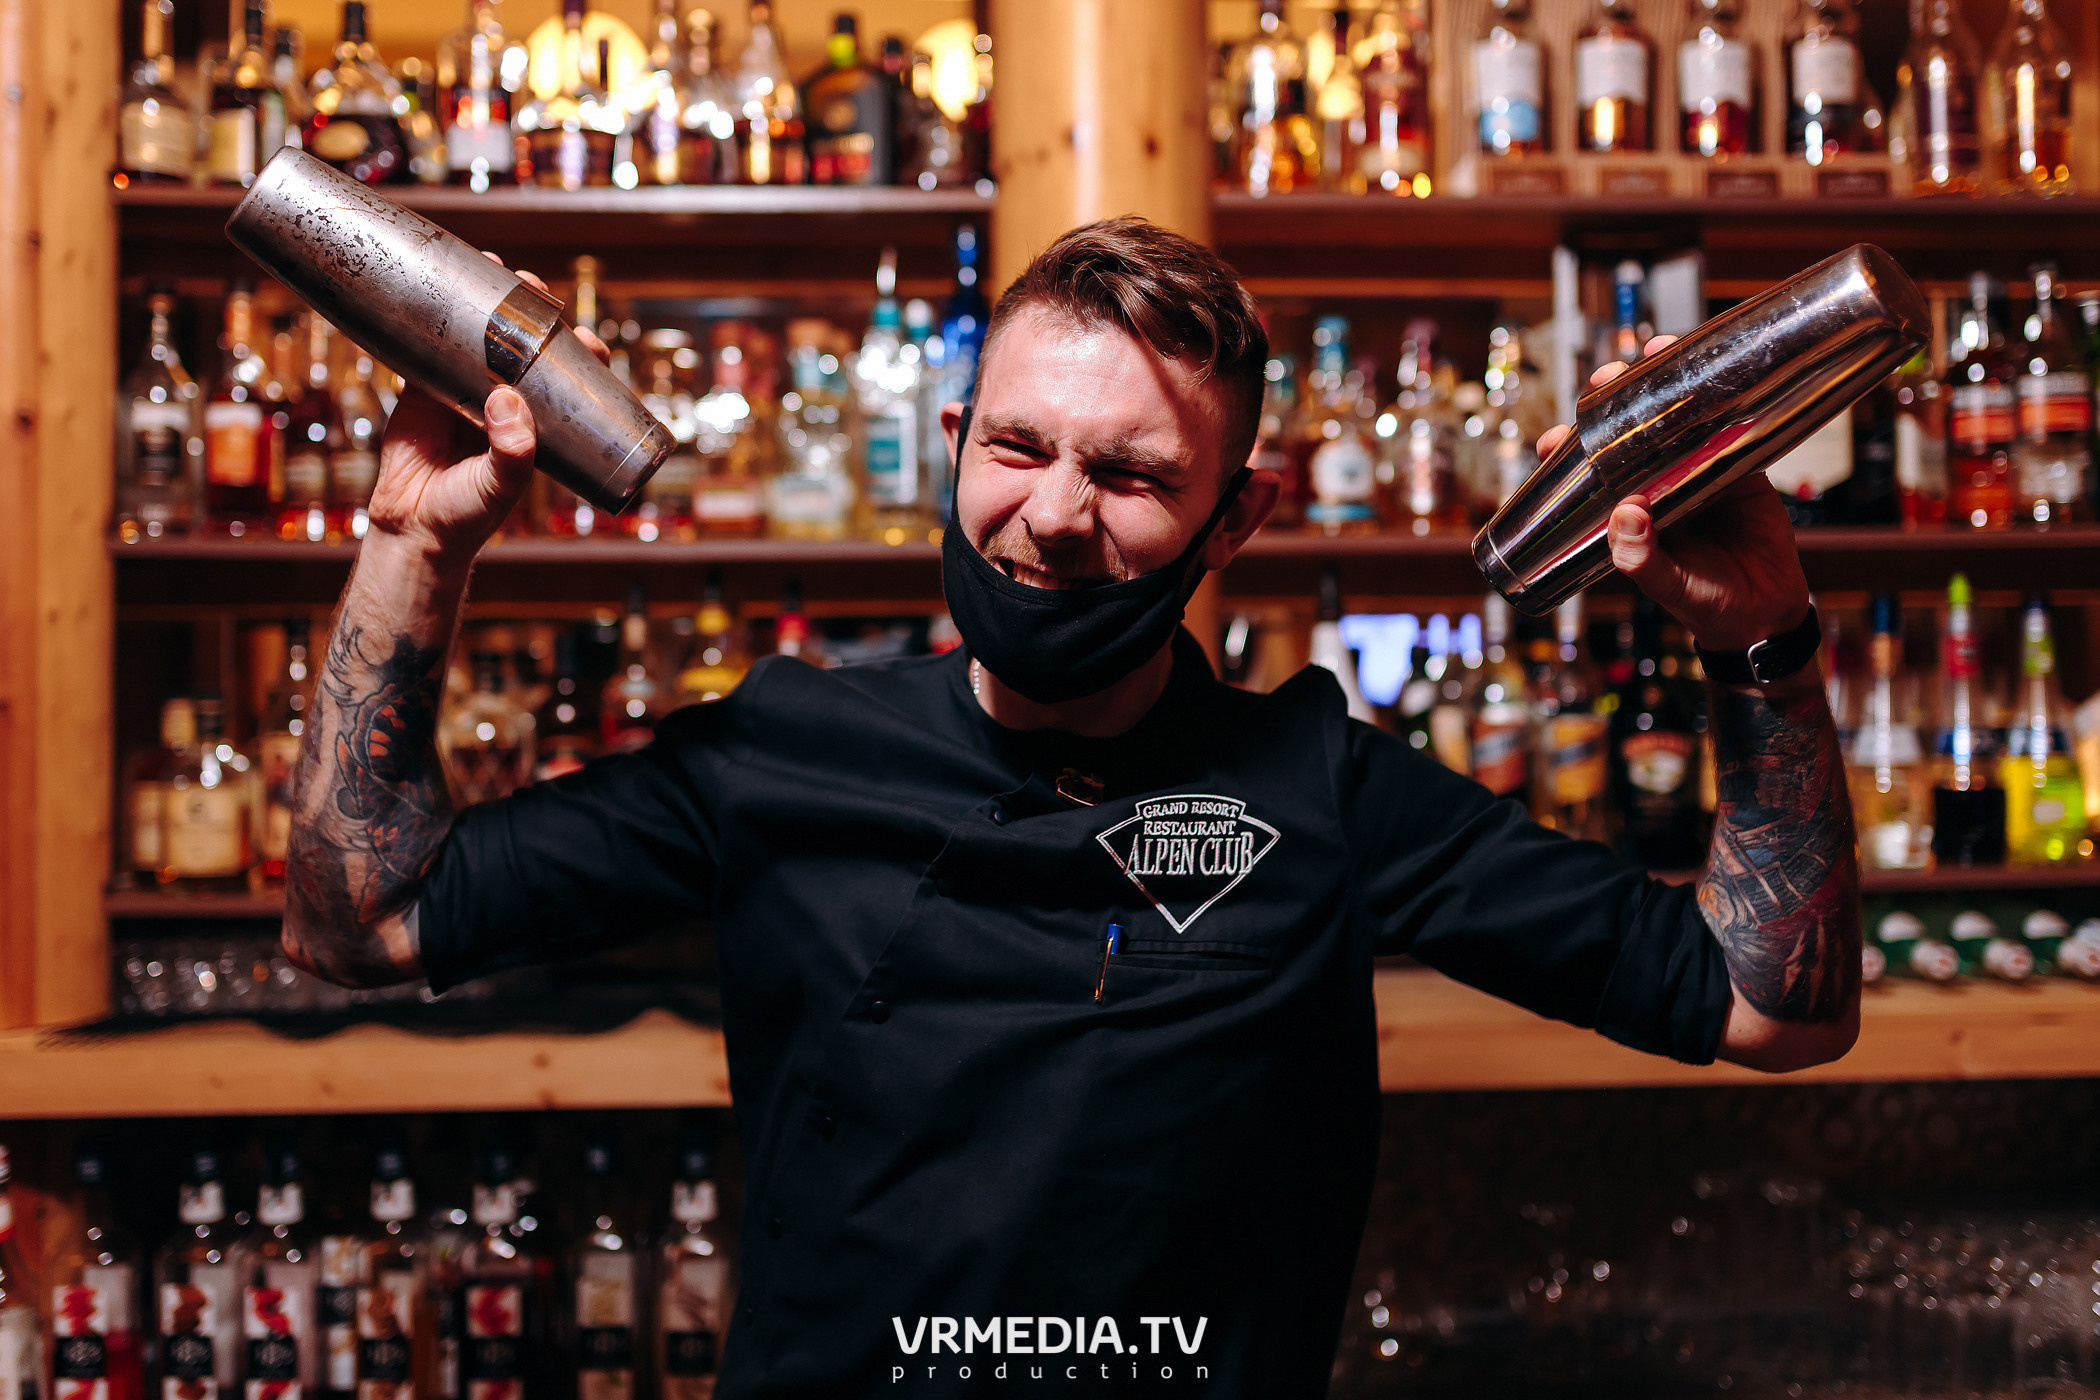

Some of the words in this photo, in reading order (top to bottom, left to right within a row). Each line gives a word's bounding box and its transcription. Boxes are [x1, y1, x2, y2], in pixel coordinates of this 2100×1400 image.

[1142, 802, 1188, 818] GRAND
[1191, 802, 1239, 818] RESORT
[1143, 821, 1237, 836] RESTAURANT
[1124, 834, 1198, 875] ALPEN
[1200, 832, 1255, 875] CLUB
